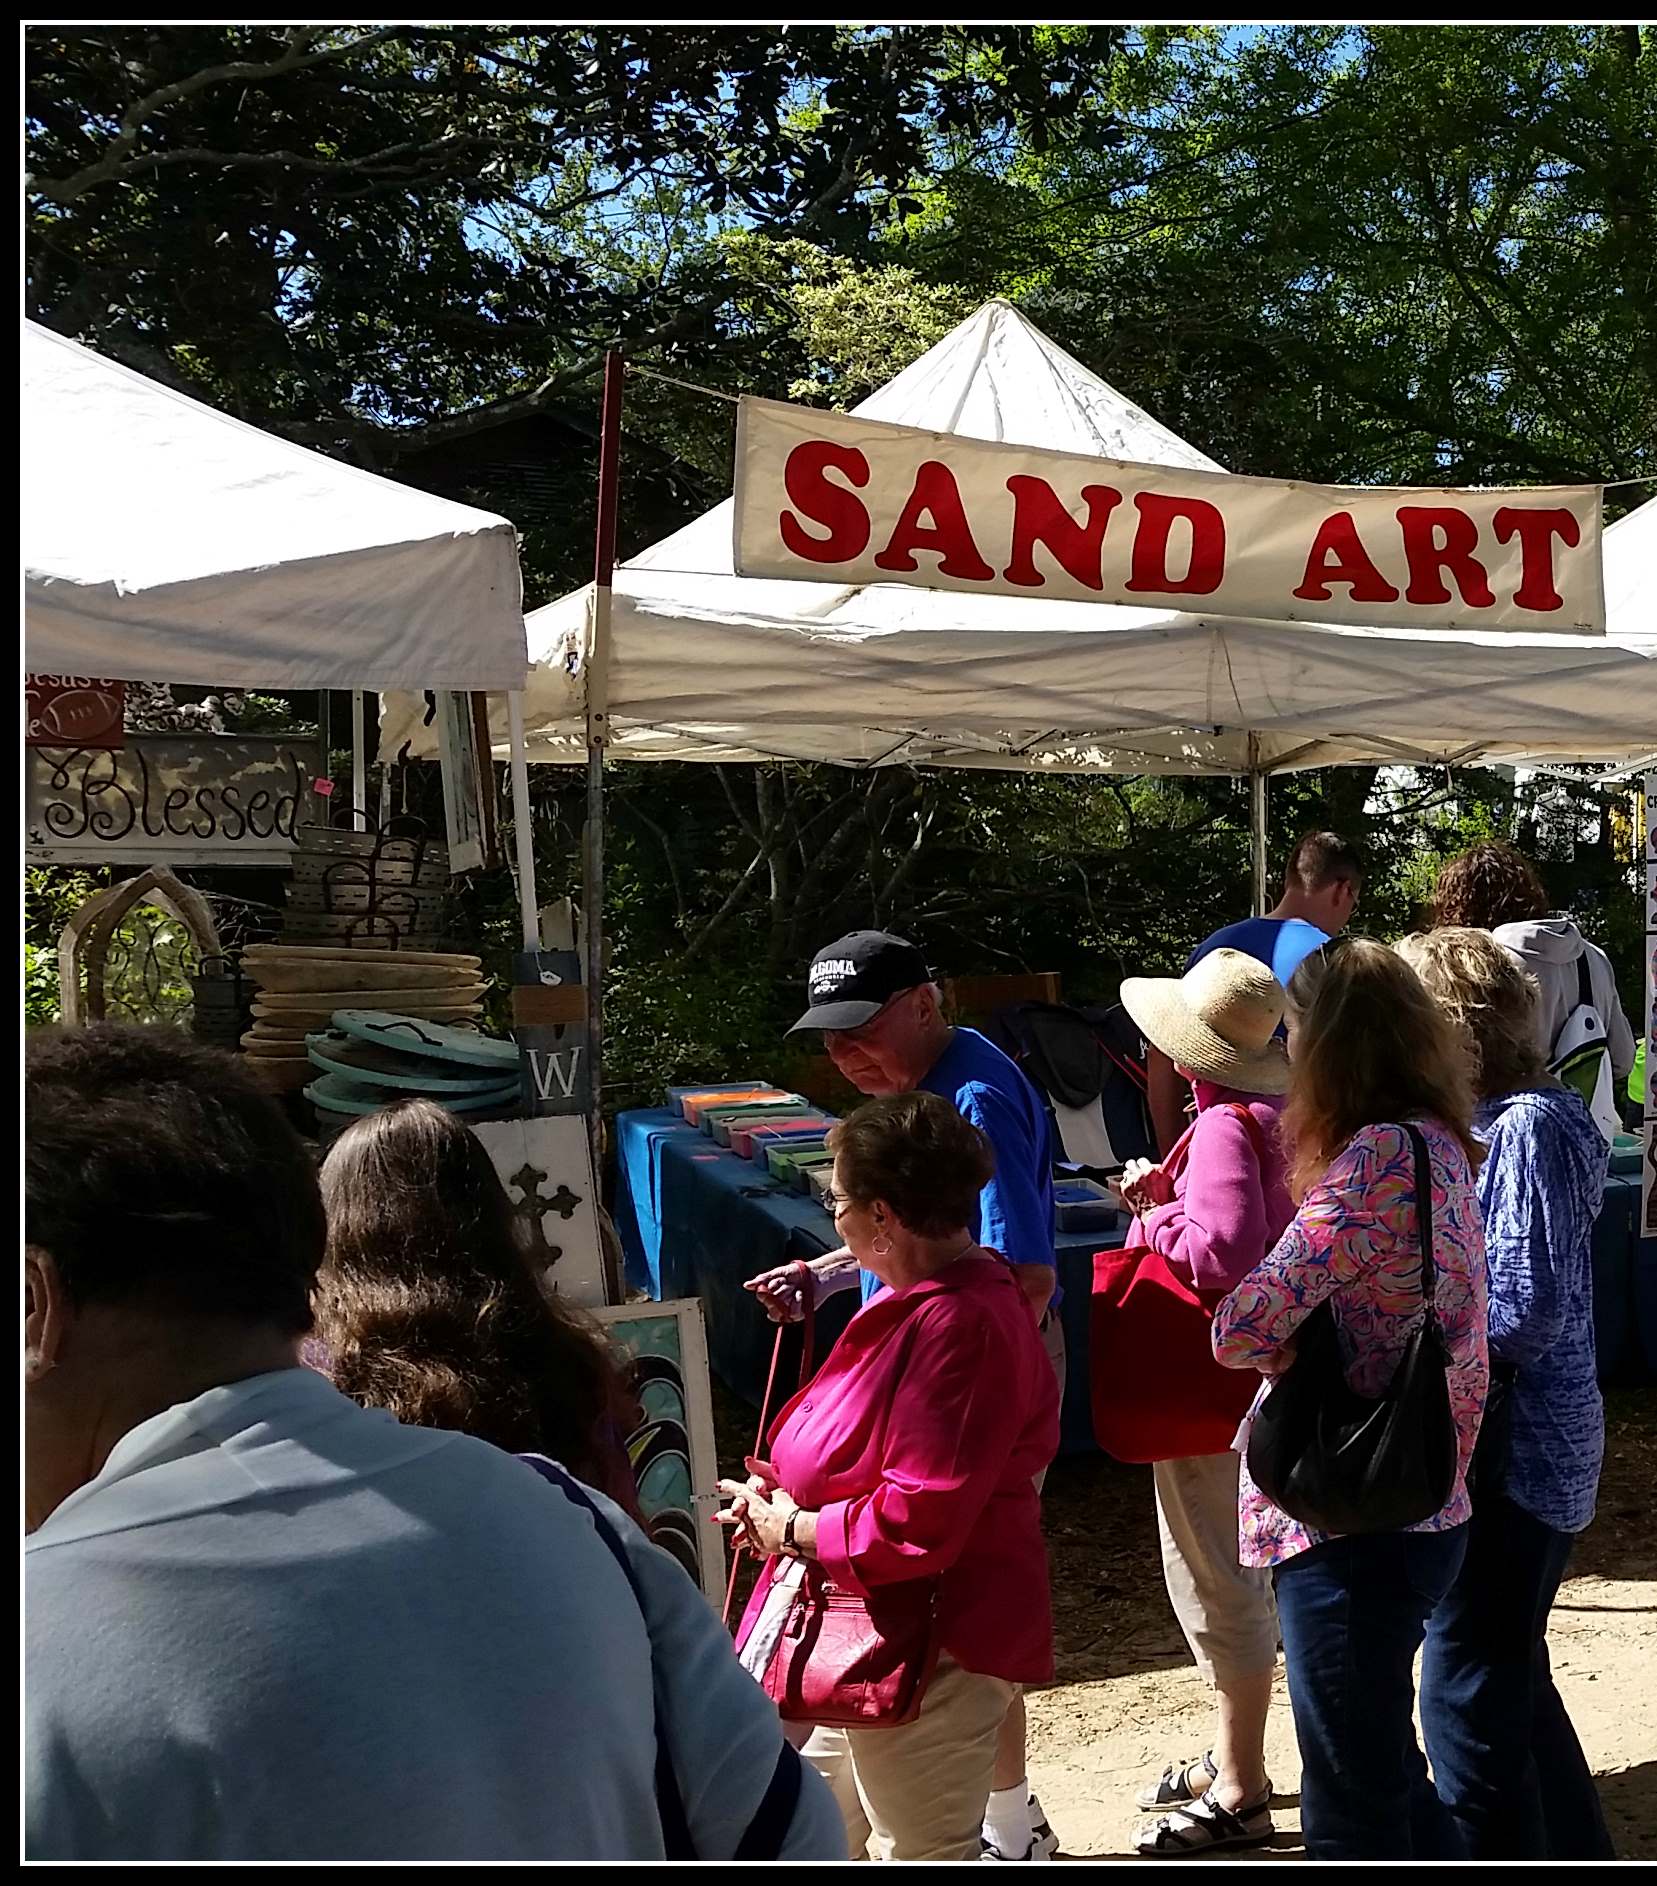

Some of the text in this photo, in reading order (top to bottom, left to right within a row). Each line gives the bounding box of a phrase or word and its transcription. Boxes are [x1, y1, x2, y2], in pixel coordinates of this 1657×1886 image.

[779, 440, 1581, 611] SAND ART
[35, 747, 300, 847] Blessed
[526, 1046, 584, 1100] W
